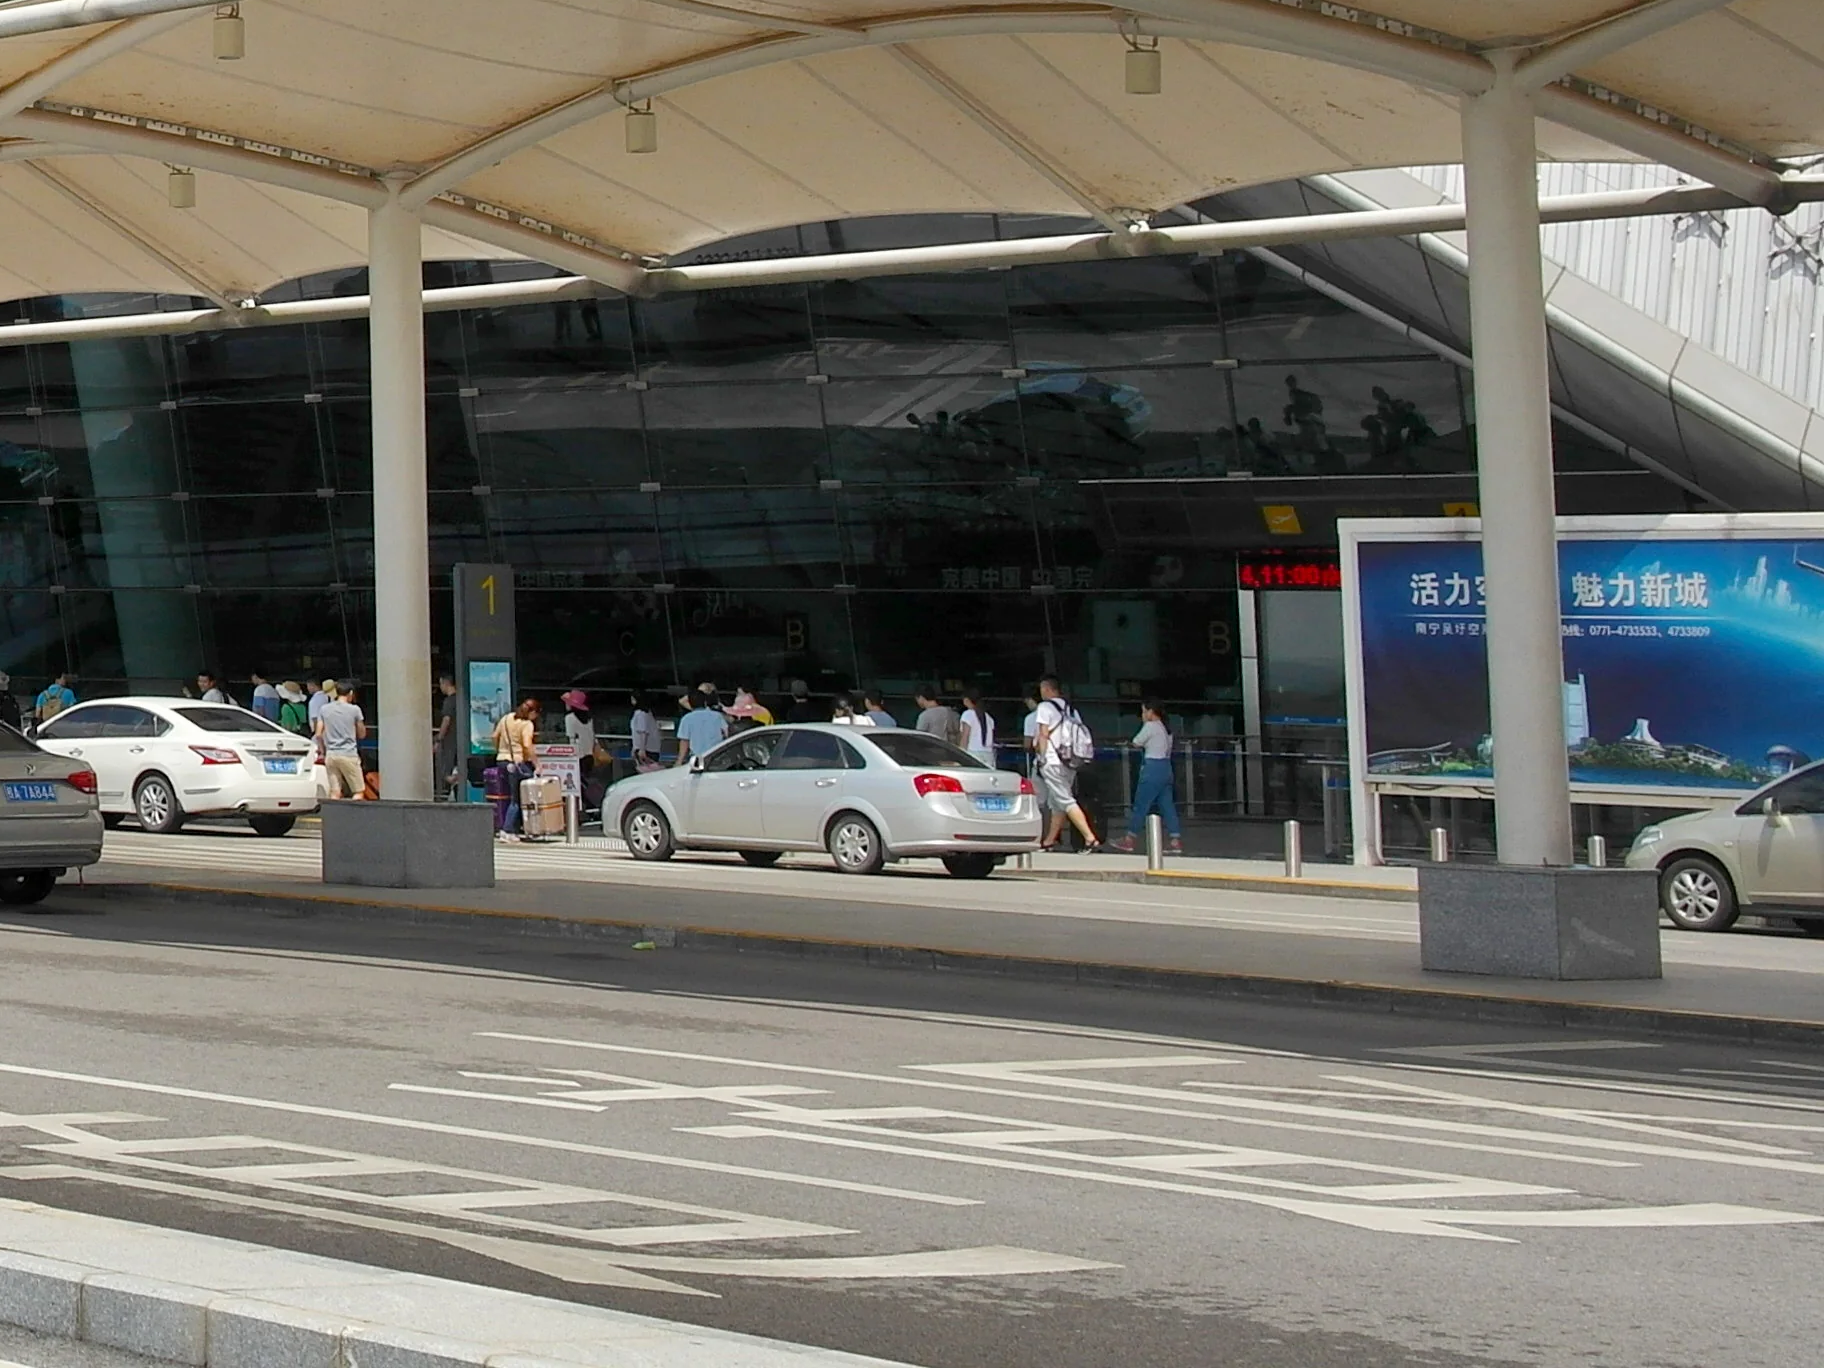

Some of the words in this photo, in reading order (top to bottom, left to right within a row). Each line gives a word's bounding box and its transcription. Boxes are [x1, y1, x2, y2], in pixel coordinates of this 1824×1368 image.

[481, 574, 495, 616] 1
[1571, 570, 1709, 609] 魅力新城
[786, 618, 806, 651] B
[1208, 620, 1231, 655] B
